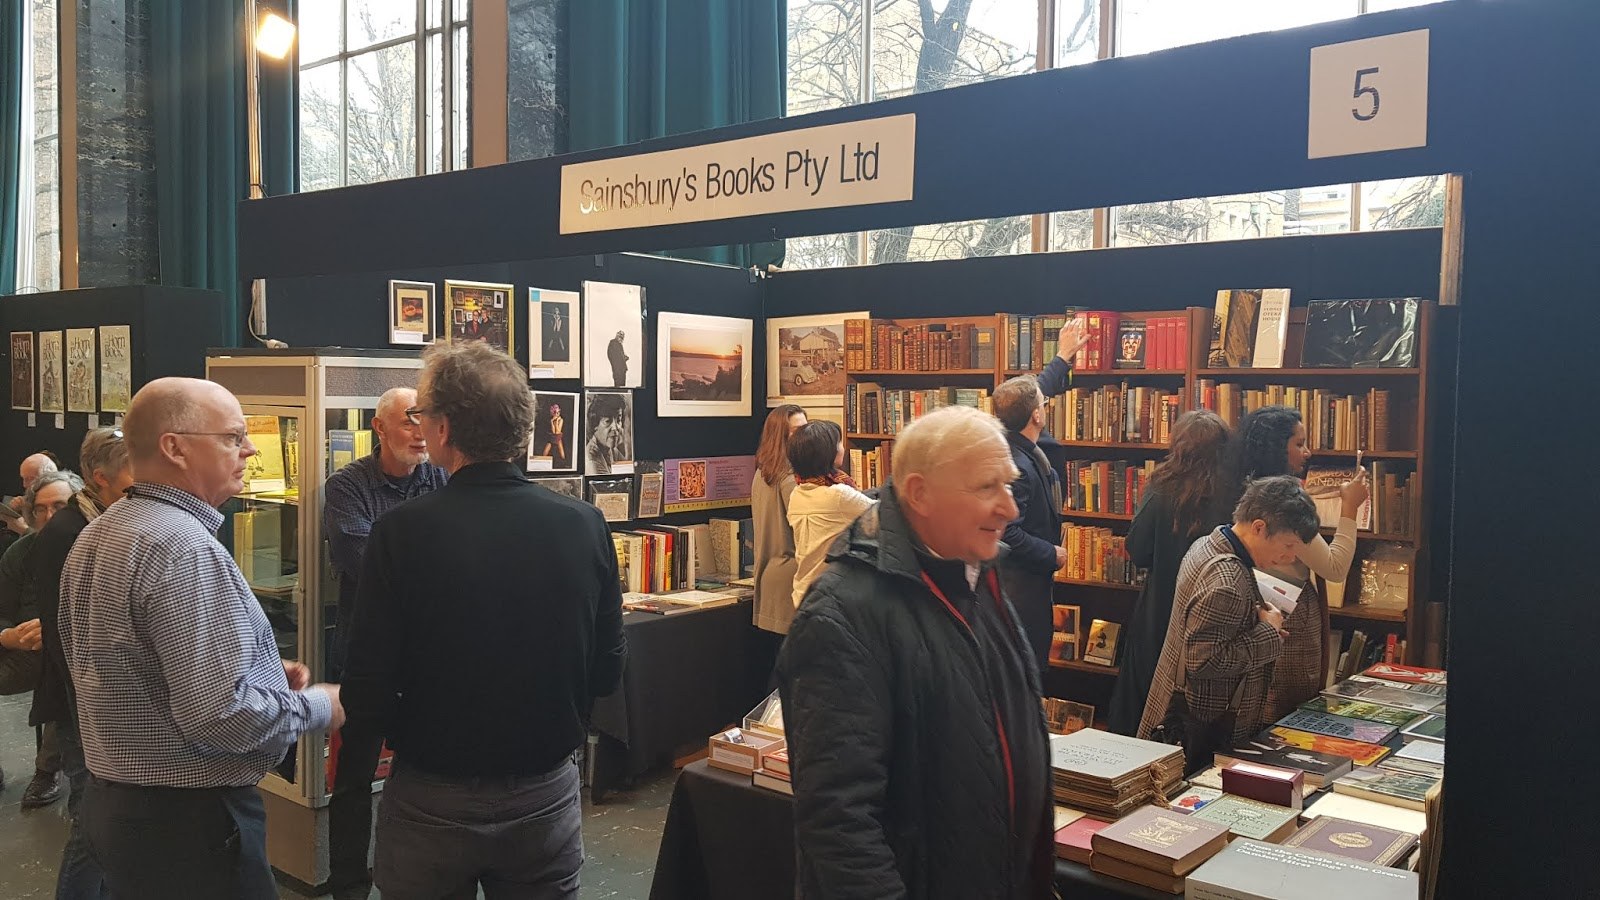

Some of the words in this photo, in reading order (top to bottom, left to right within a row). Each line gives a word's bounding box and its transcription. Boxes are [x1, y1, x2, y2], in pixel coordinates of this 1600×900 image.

[1351, 66, 1380, 121] 5
[580, 167, 697, 214] Sainsbury's
[705, 157, 775, 199] Books
[785, 149, 829, 196] Pty
[839, 142, 880, 184] Ltd
[1235, 848, 1280, 862] Damien
[1280, 858, 1312, 869] Hirst
[1242, 841, 1273, 851] From
[1273, 848, 1293, 856] the
[1294, 853, 1334, 864] Cradle
[1350, 863, 1369, 872] the
[1371, 868, 1407, 880] Grave
[1288, 855, 1342, 871] Drawings
